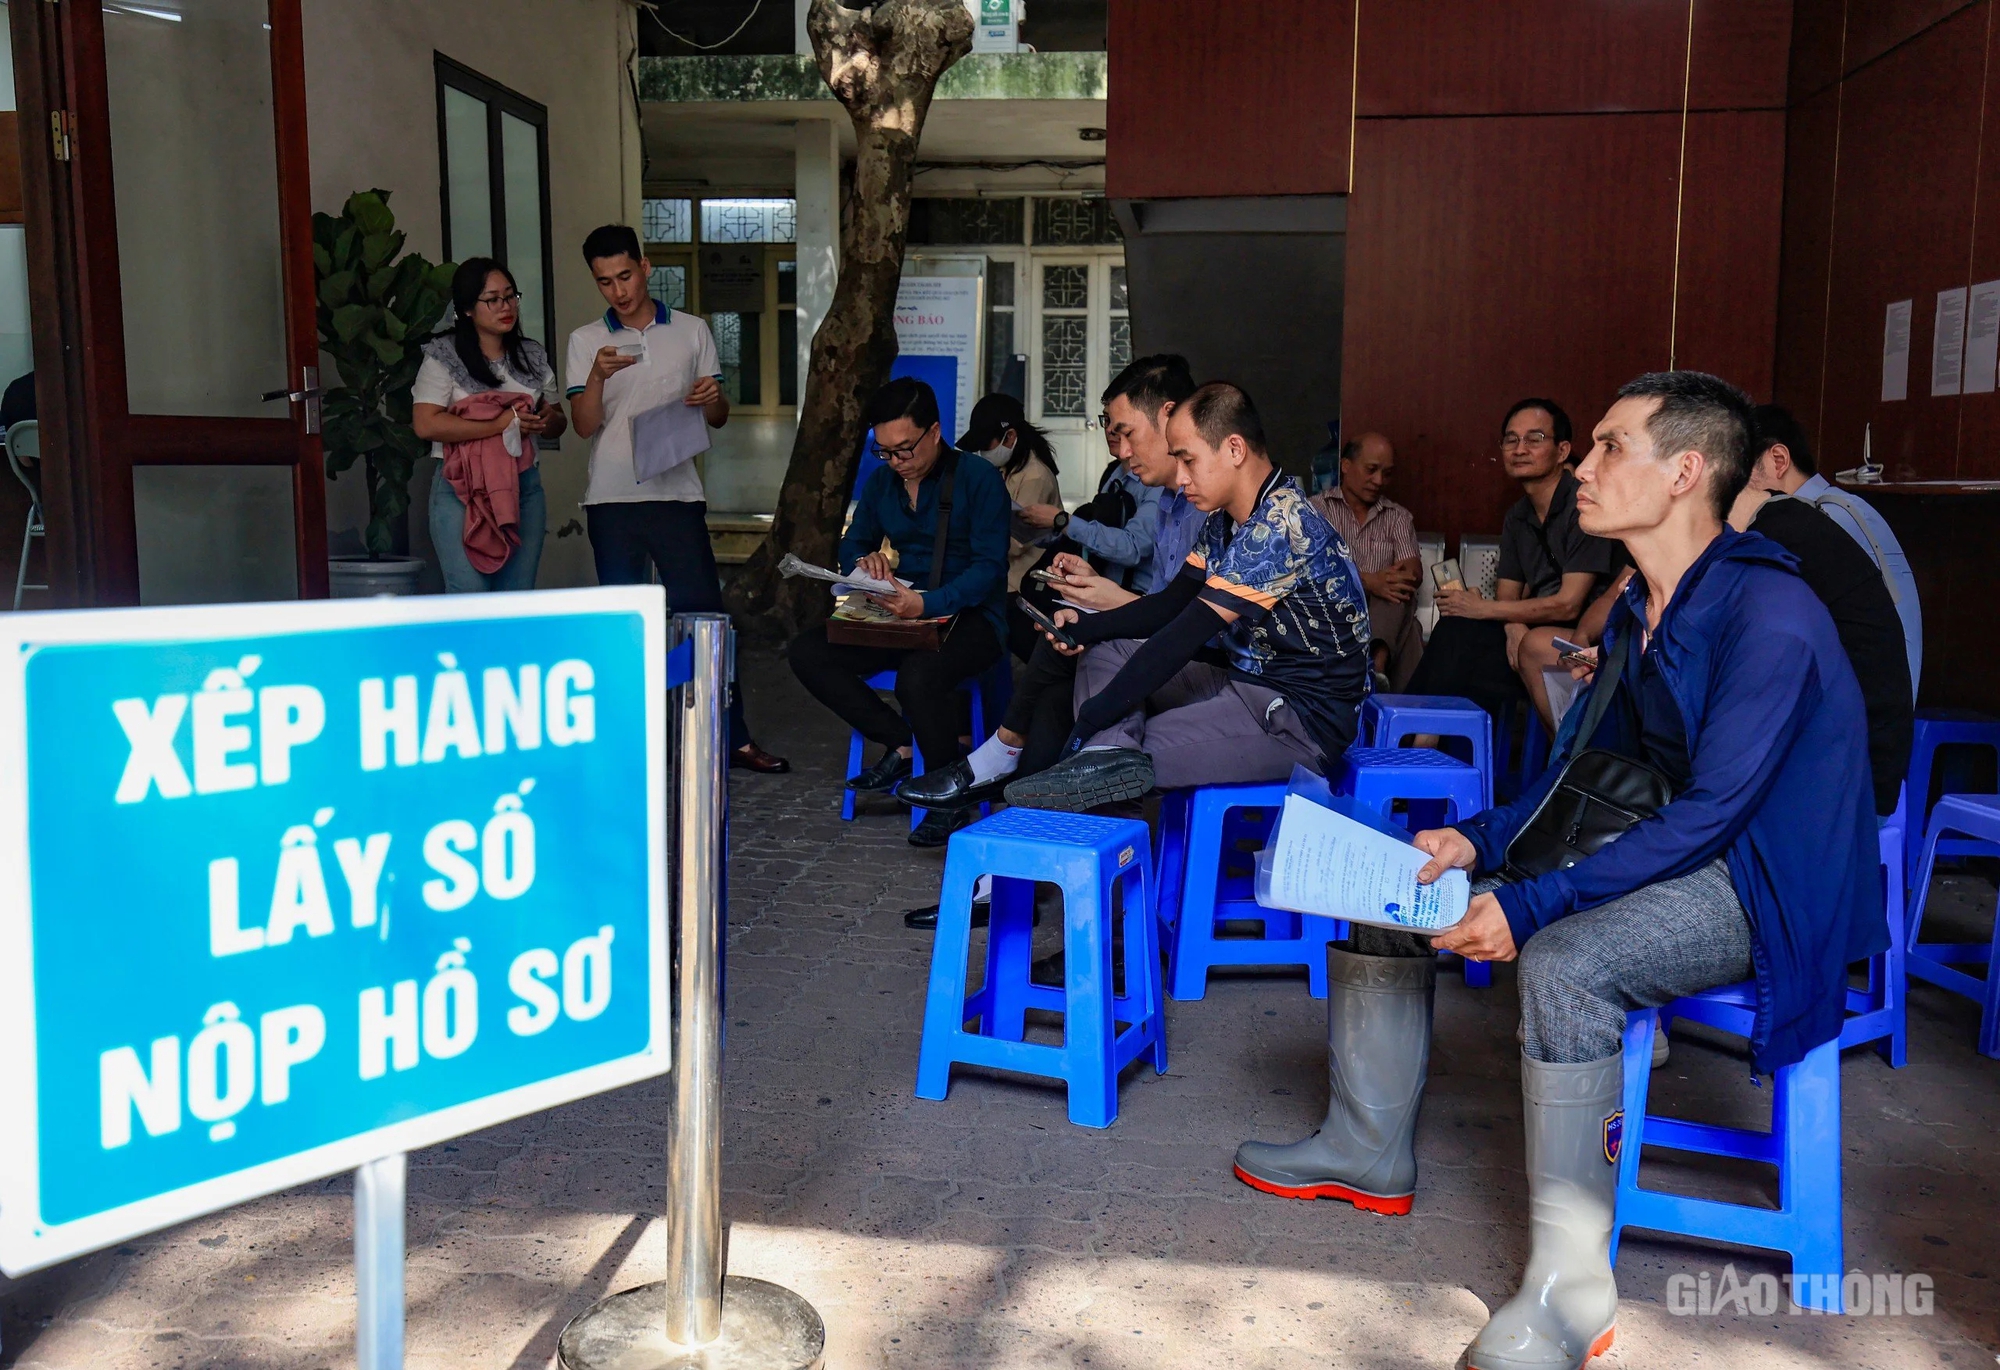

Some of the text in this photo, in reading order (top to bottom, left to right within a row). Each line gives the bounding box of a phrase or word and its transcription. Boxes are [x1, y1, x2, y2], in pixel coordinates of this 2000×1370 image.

[918, 313, 944, 325] BÁO
[113, 652, 596, 804] XẾP HÀNG
[209, 778, 535, 957] LẤY SỐ
[100, 925, 615, 1149] NỘP HỒ SƠ
